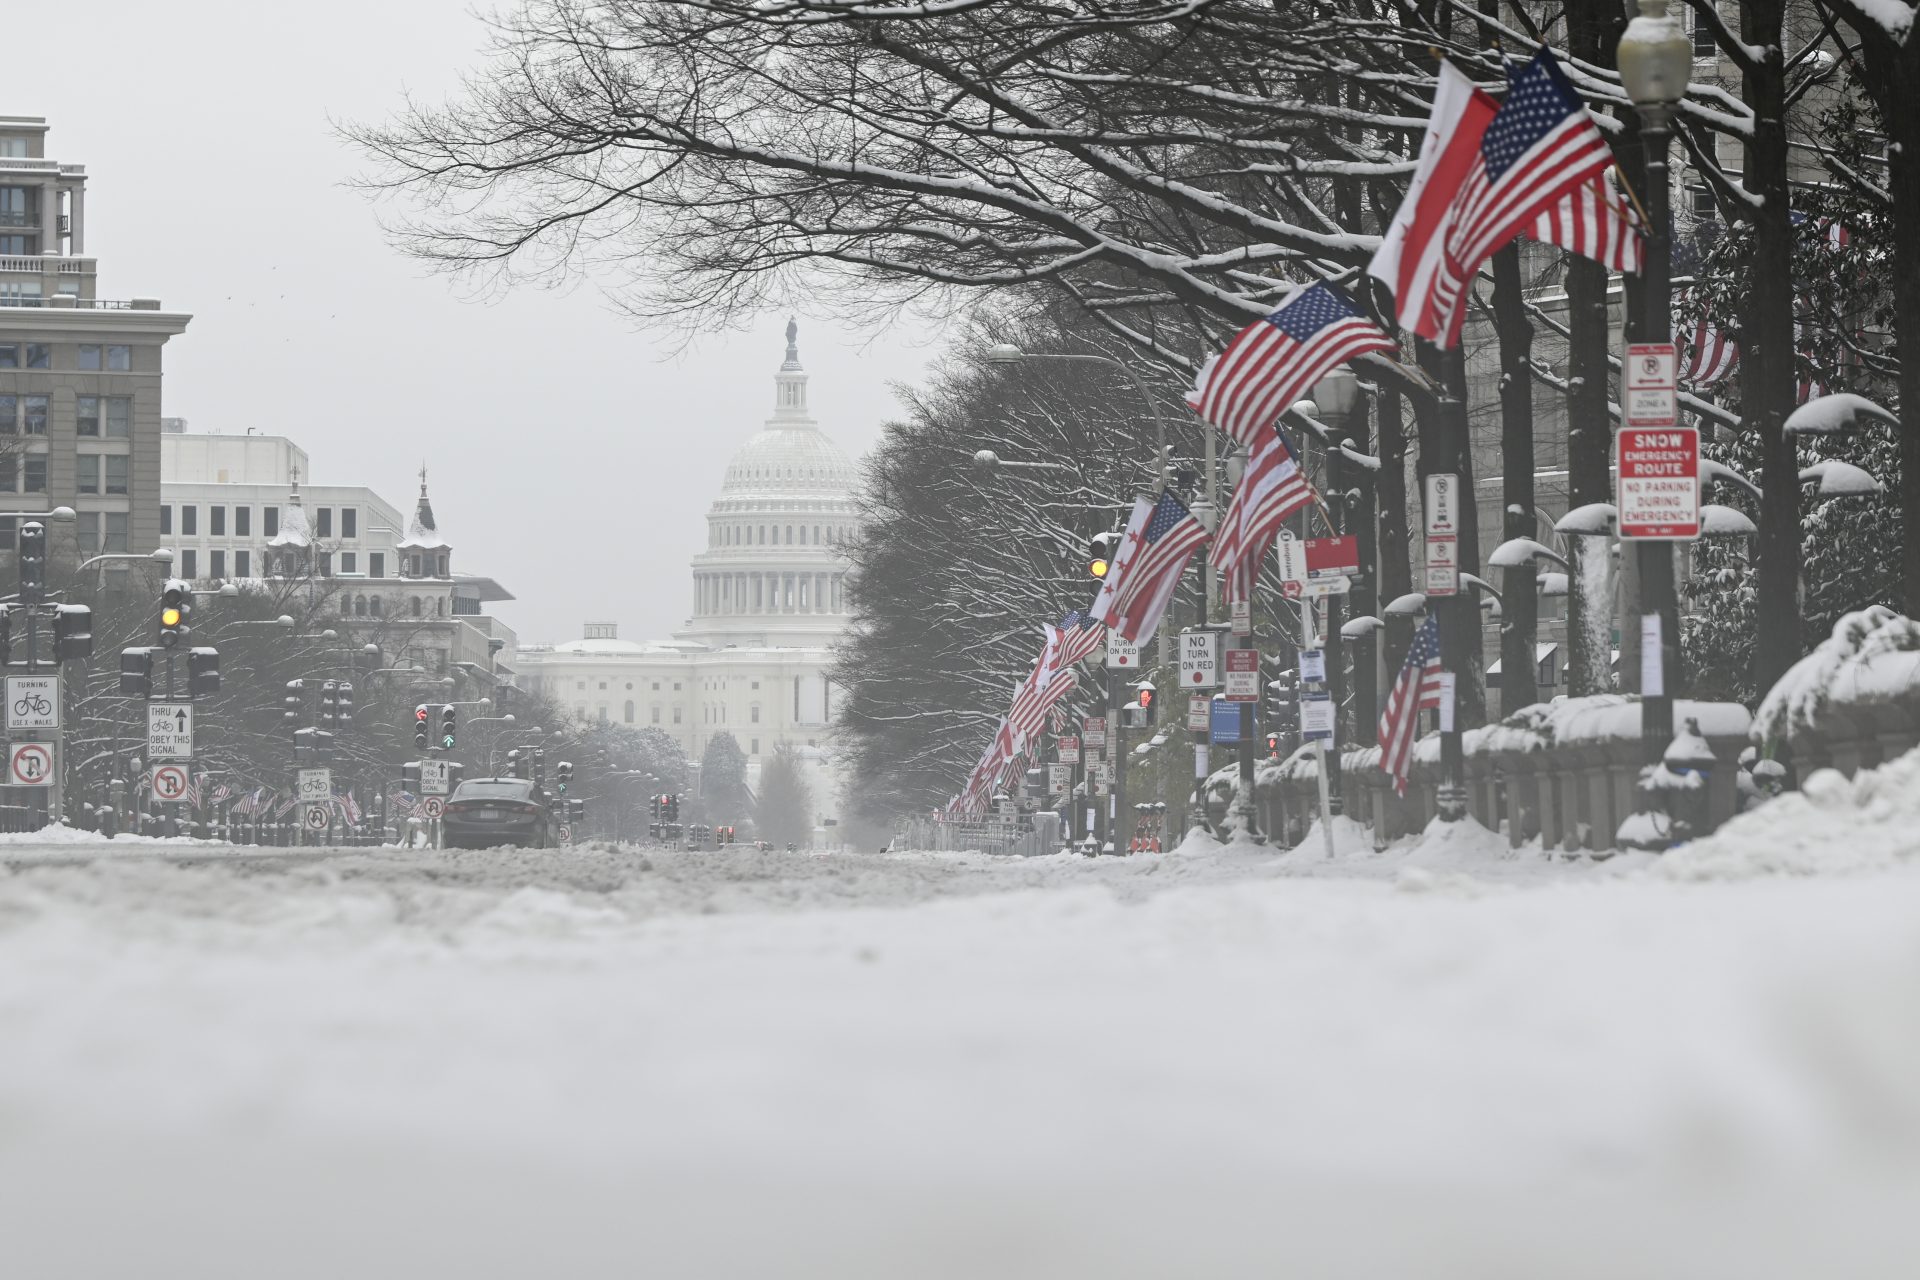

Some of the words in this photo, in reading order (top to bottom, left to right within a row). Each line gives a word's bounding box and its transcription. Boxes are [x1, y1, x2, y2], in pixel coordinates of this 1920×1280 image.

[1634, 434, 1683, 448] SNOW
[1624, 451, 1691, 461] EMERGENCY
[1634, 463, 1683, 475] ROUTE
[1626, 482, 1640, 492] NO
[1646, 482, 1690, 492] PARKING
[1637, 496, 1680, 507] DURING
[1624, 511, 1691, 521] EMERGENCY
[1284, 543, 1292, 578] metrobus
[1190, 637, 1205, 646] NO
[1187, 650, 1208, 658] TURN
[1182, 662, 1193, 670] ON
[1198, 661, 1213, 669] RED
[151, 708, 170, 716] THRU
